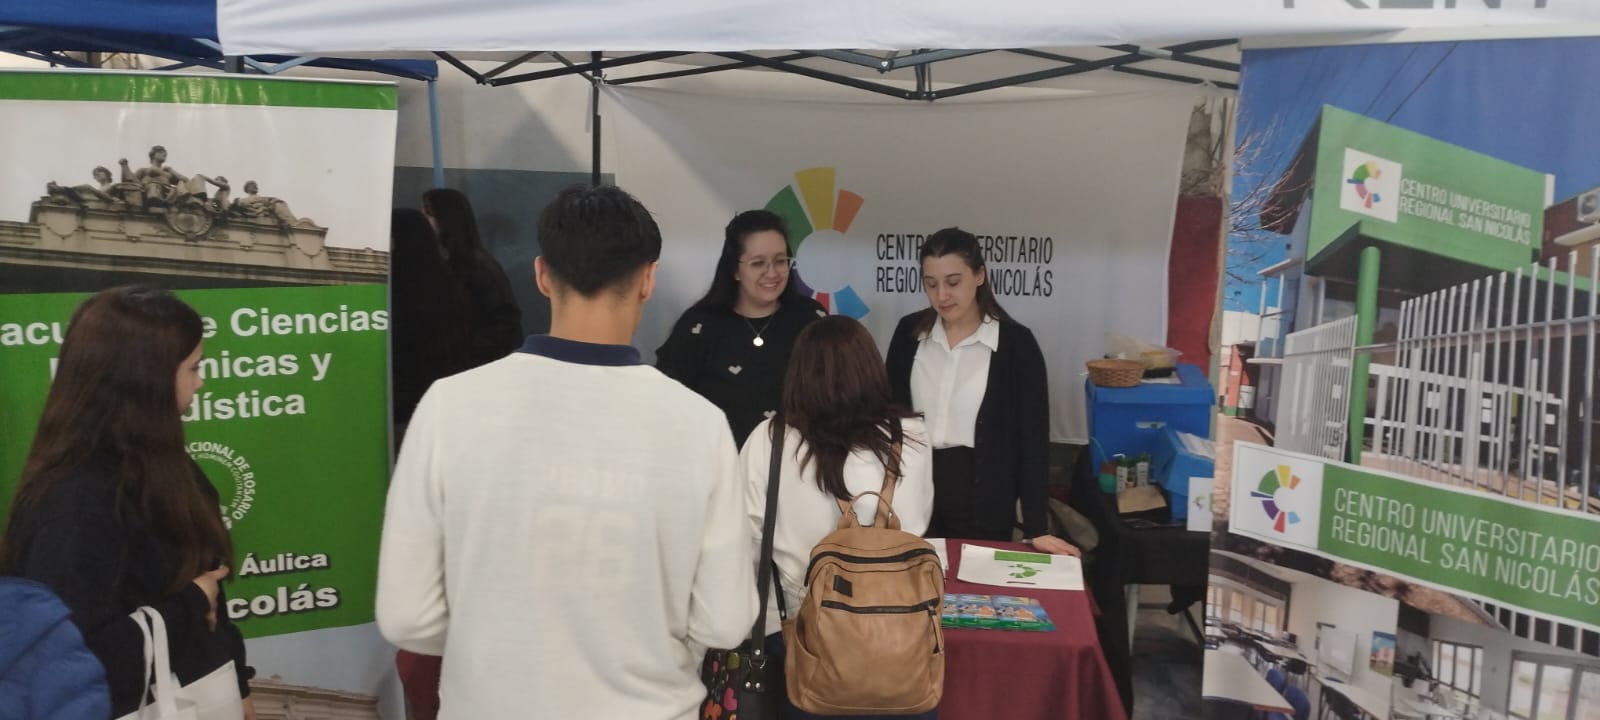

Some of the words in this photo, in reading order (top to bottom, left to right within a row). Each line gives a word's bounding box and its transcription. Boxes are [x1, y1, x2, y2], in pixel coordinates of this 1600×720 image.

[1399, 196, 1454, 225] REGIONAL
[1459, 212, 1483, 233] SAN
[1400, 178, 1447, 205] CENTRO
[1450, 191, 1532, 228] UNIVERSITARIO
[876, 233, 930, 261] CENTR
[976, 236, 1053, 264] RSITARIO
[876, 266, 923, 293] REGIO
[990, 265, 1053, 297] NICOLÁS
[230, 304, 389, 338] Ciencias
[310, 352, 333, 381] y
[181, 390, 306, 422] dística
[184, 441, 235, 460] CIONAL
[233, 455, 250, 472] DE
[232, 471, 256, 520] ROSARIO
[1333, 487, 1416, 529] CENTRO
[1421, 507, 1600, 573] UNIVERSITARIO
[239, 552, 328, 576] Áulica
[1331, 515, 1432, 564] REGIONAL
[1440, 542, 1489, 578] SAN
[1495, 554, 1600, 605] NICOLÁS
[226, 583, 339, 619] colás
